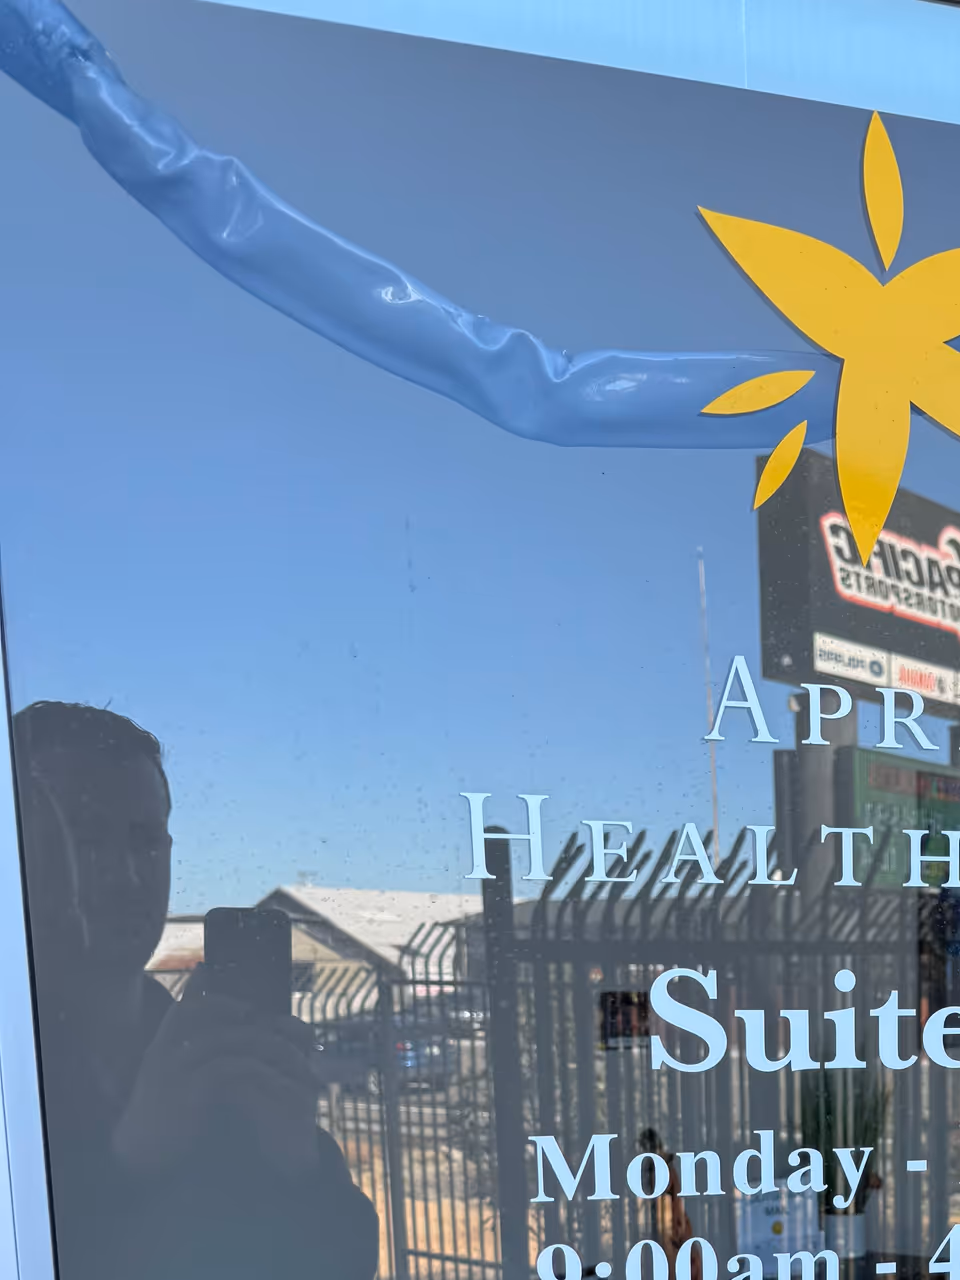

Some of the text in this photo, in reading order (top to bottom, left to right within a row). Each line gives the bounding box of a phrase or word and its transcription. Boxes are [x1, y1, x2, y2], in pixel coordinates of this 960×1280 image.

[528, 1129, 874, 1209] Monday
[906, 1158, 927, 1172] -
[875, 1260, 897, 1275] -
